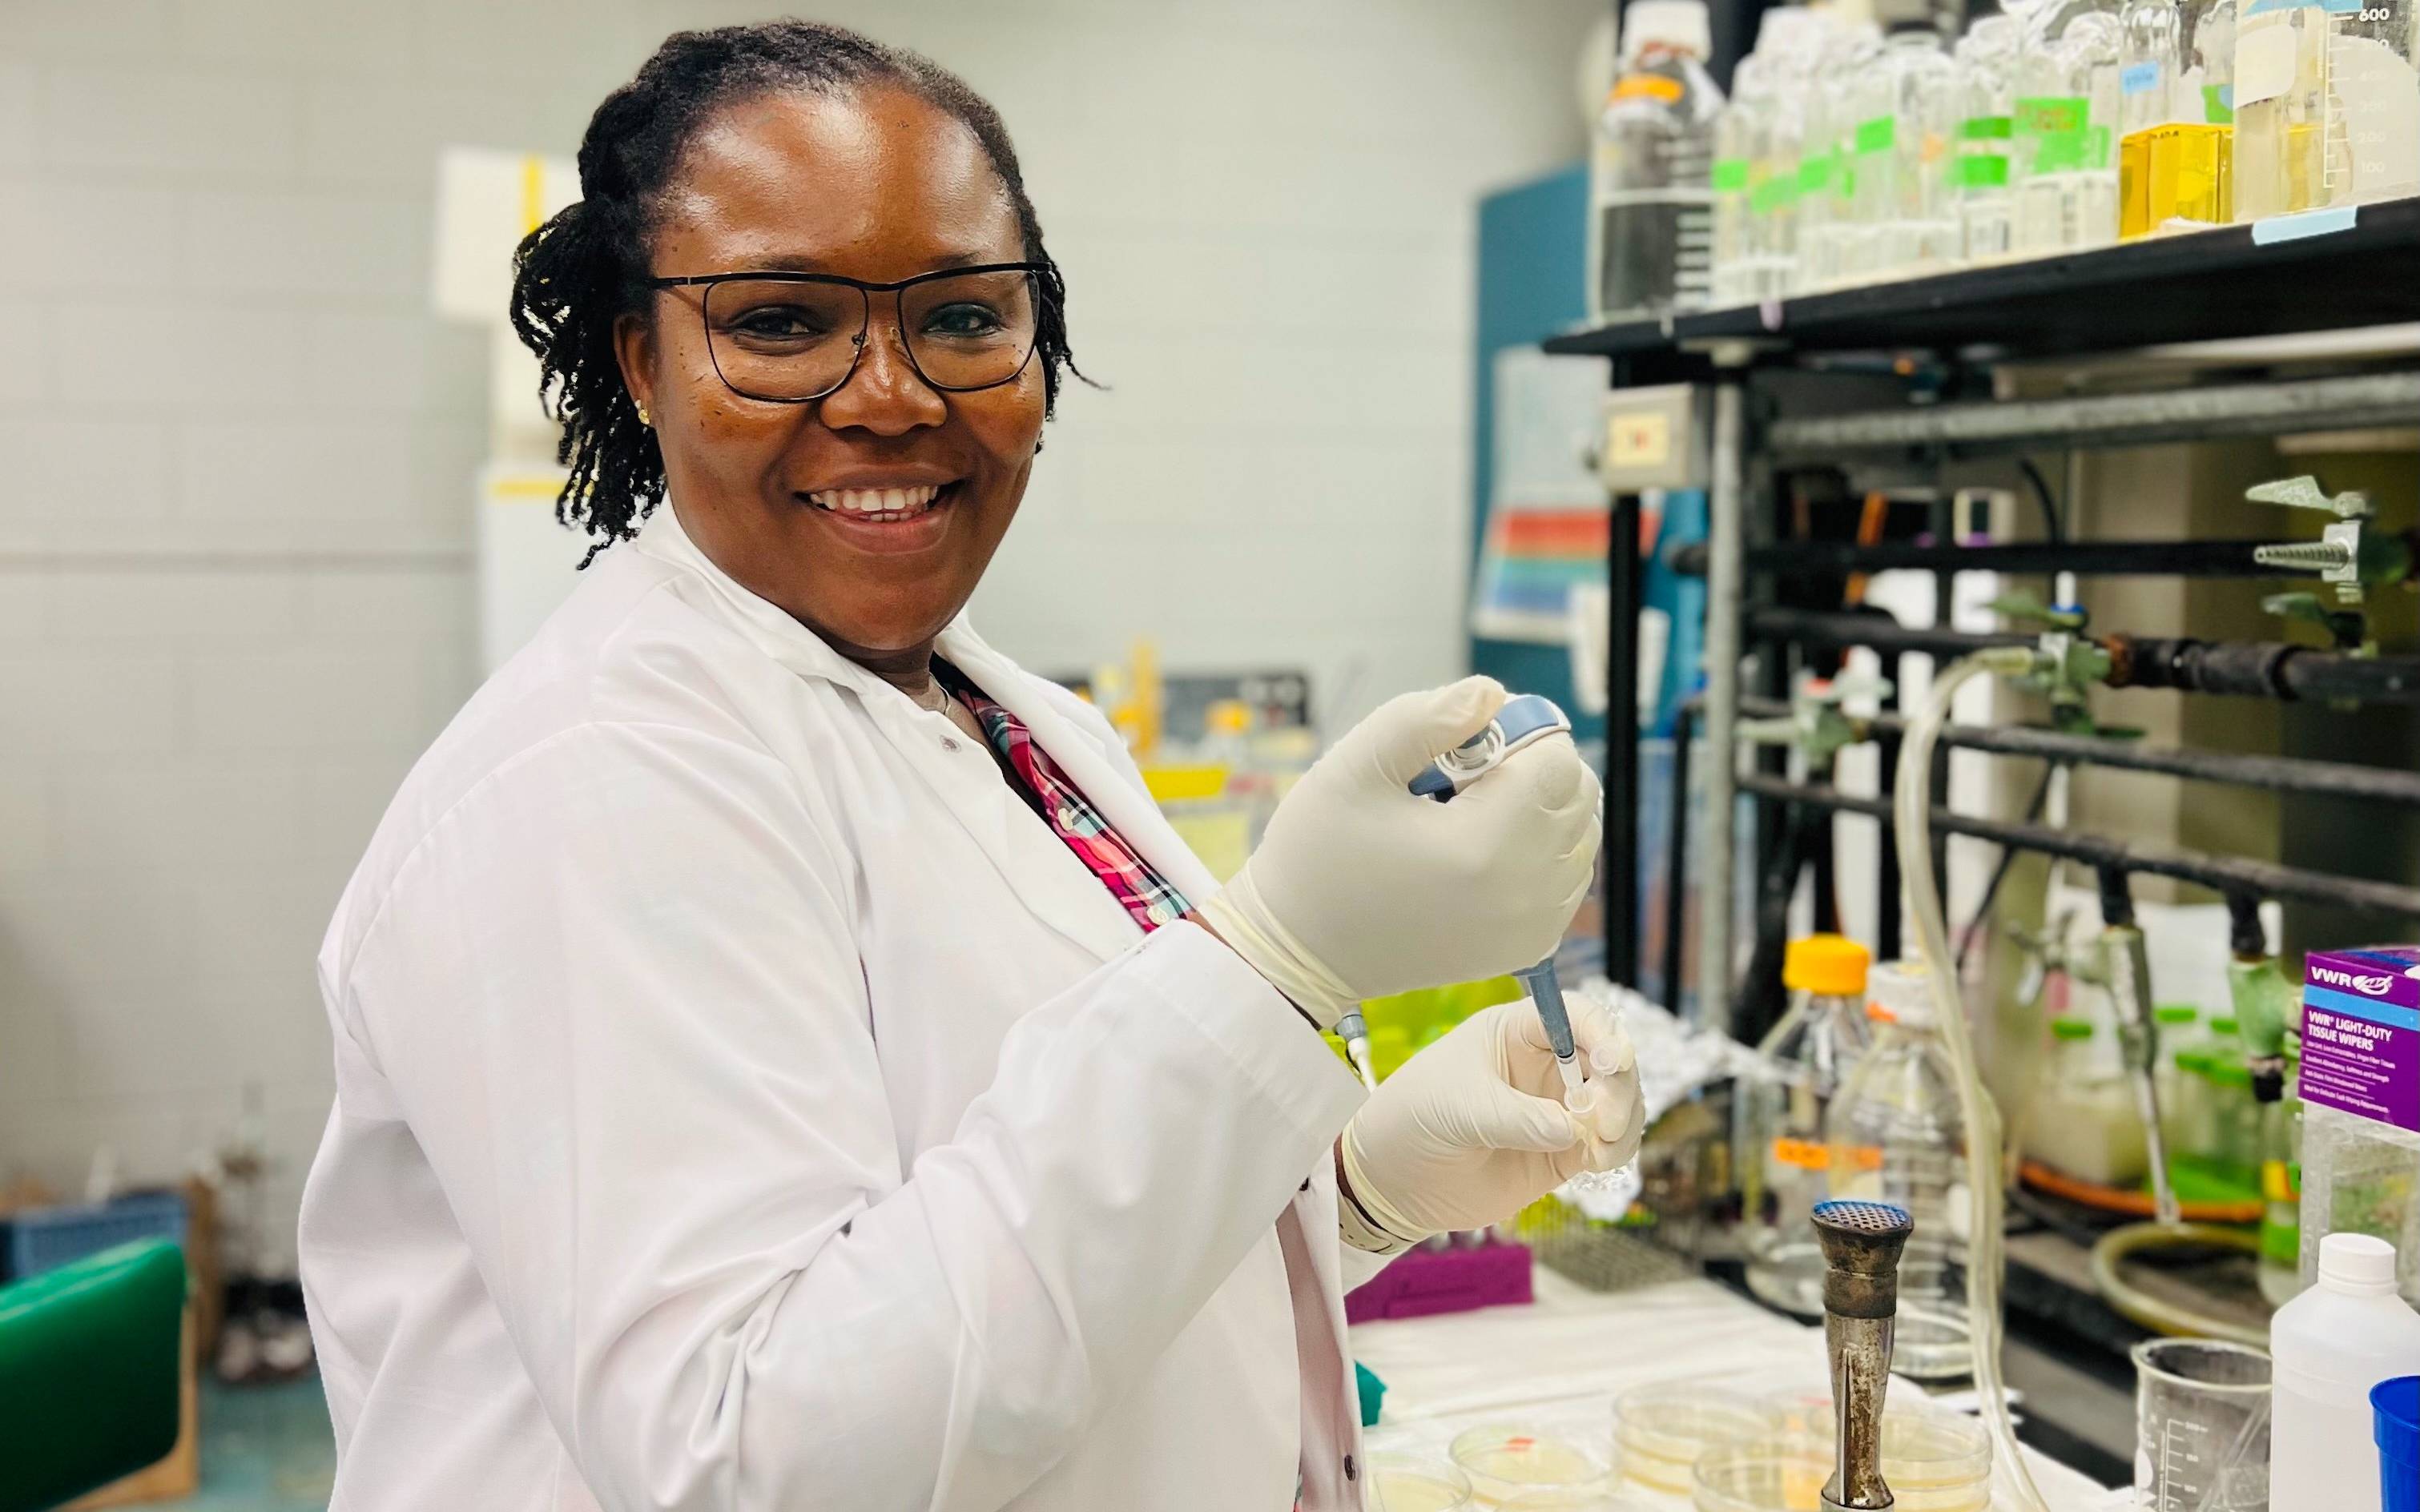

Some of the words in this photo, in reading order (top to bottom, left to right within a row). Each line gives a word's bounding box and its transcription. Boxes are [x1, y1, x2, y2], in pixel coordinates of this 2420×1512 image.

[2358, 8, 2390, 22] 600
[2311, 966, 2351, 987] VWR
[2308, 1023, 2337, 1043] TISSUE
[2339, 1032, 2374, 1052] WIPERS
[2335, 1017, 2392, 1042] LIGHT-DUTY
